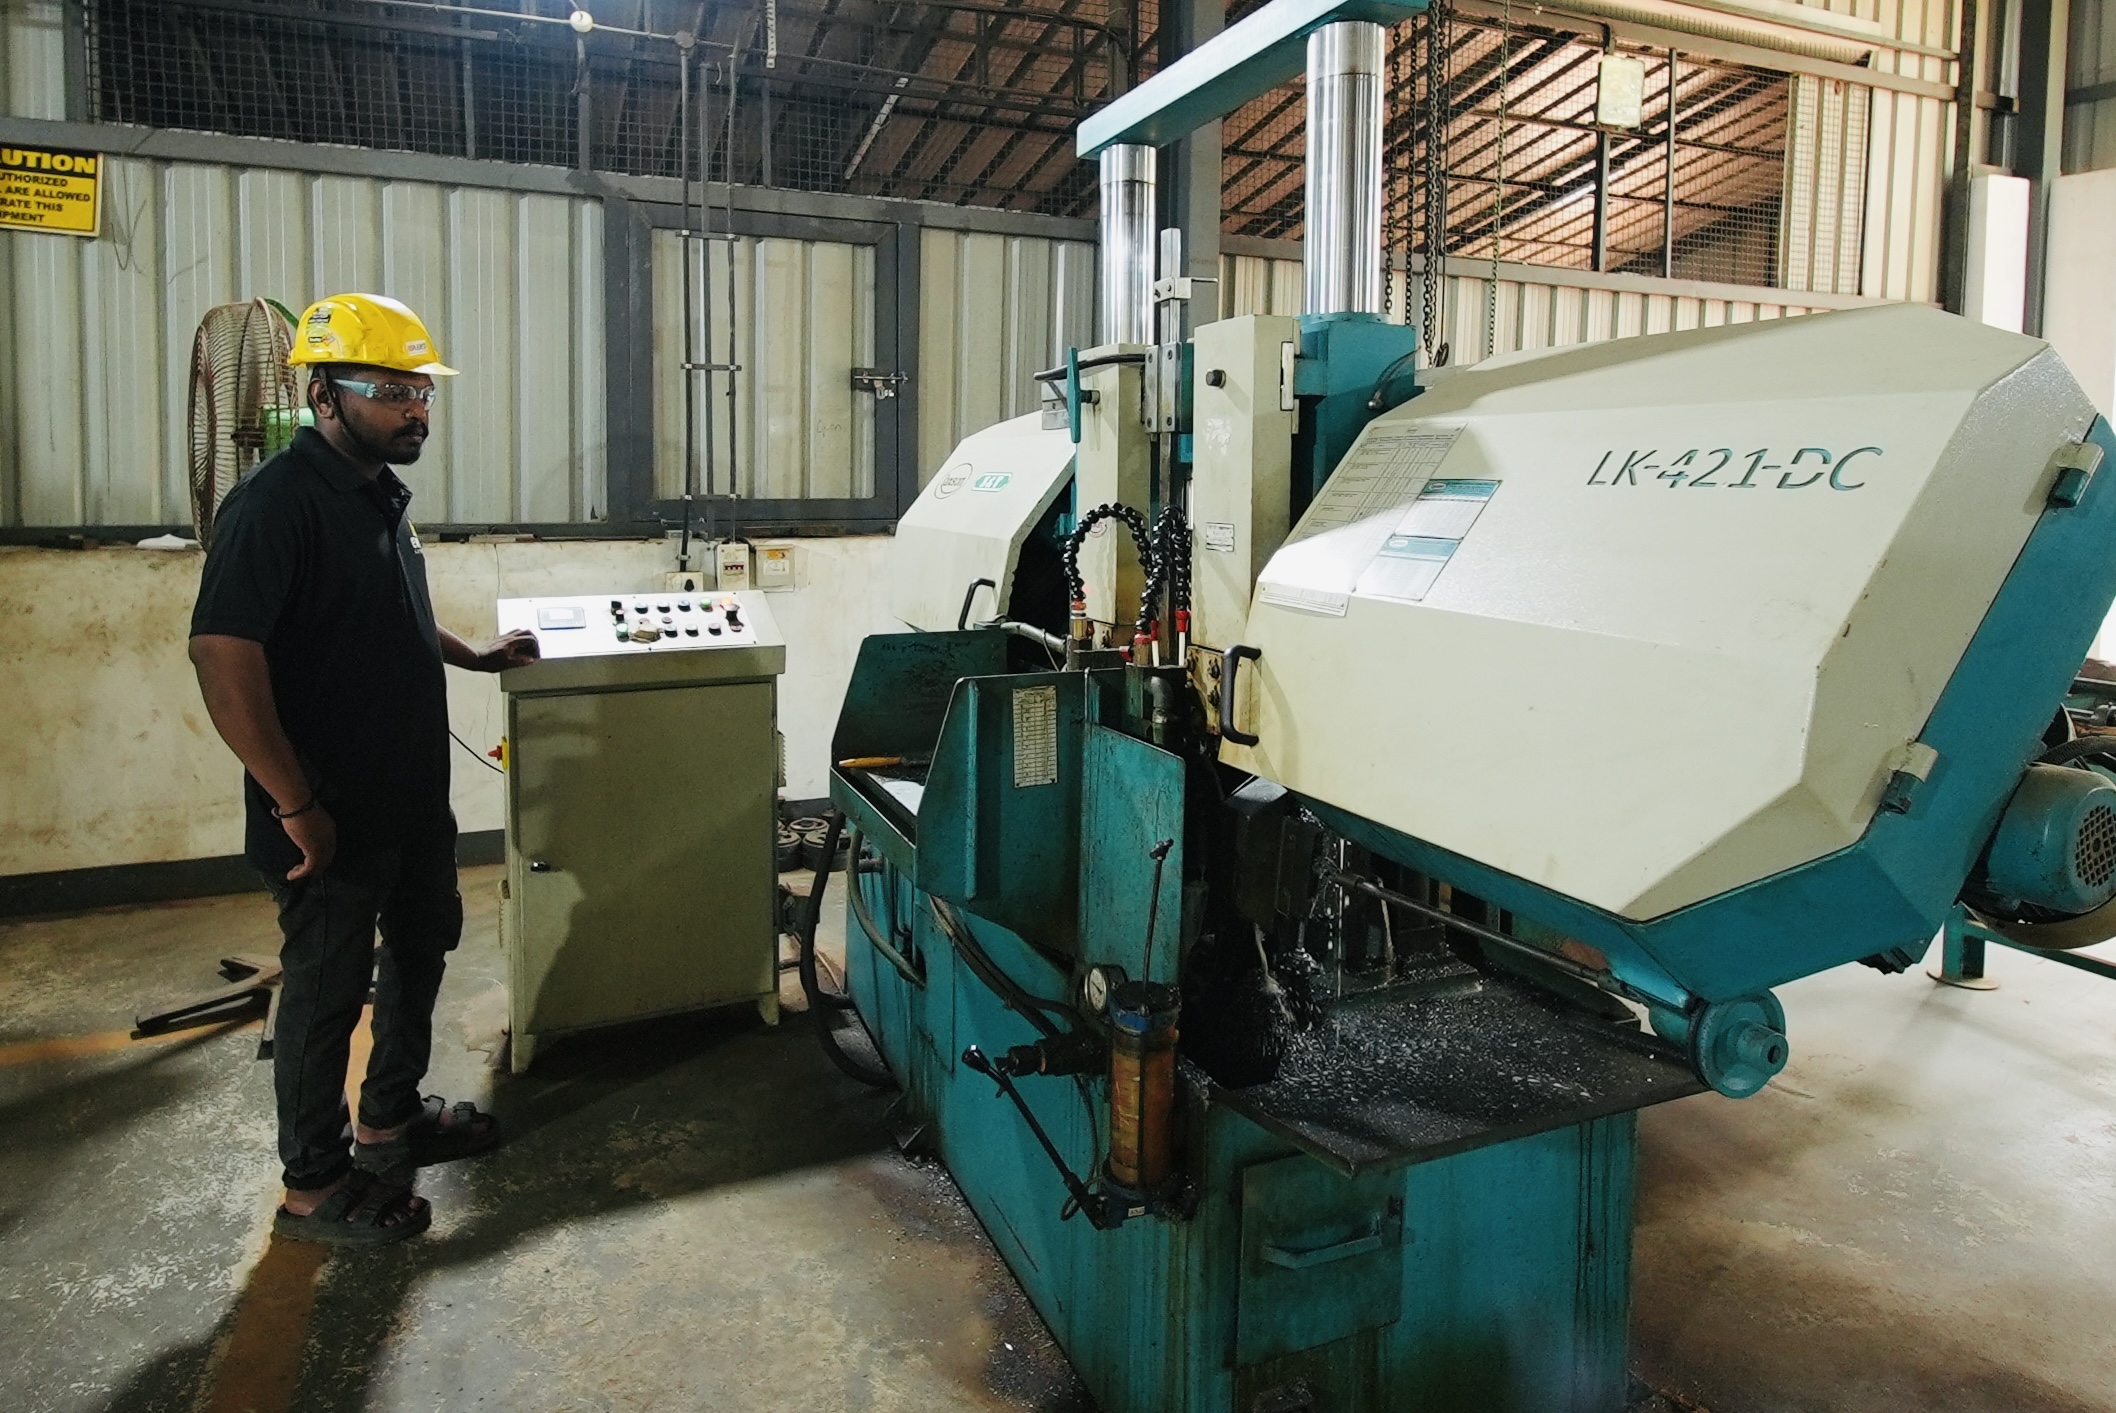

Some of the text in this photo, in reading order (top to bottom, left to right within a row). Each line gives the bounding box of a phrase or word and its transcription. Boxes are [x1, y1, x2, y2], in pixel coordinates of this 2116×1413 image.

[5, 185, 91, 202] ARE ALLOWED
[36, 201, 64, 213] THIS
[1586, 446, 1884, 491] LK-421-DC
